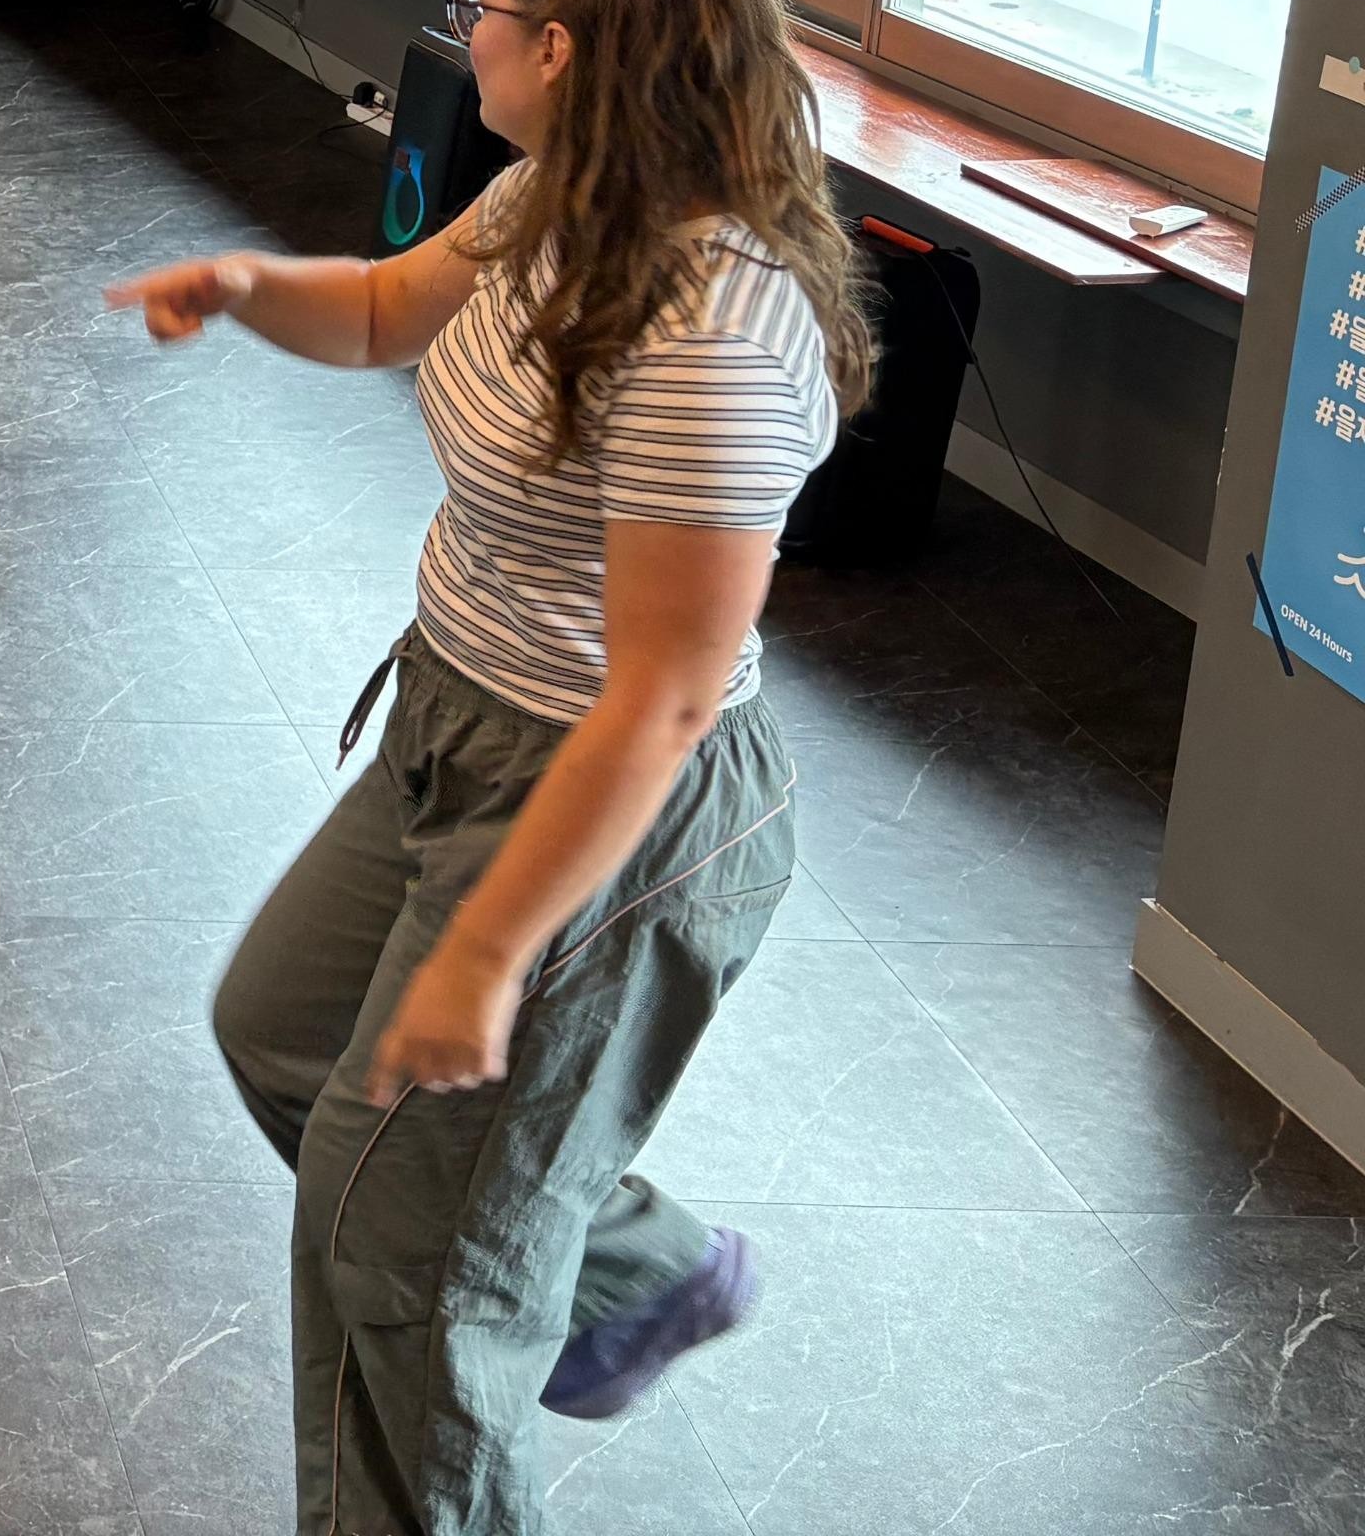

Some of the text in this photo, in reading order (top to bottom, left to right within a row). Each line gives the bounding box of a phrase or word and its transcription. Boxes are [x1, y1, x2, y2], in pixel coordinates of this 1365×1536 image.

[1281, 604, 1353, 663] OPEN 24 Hours
